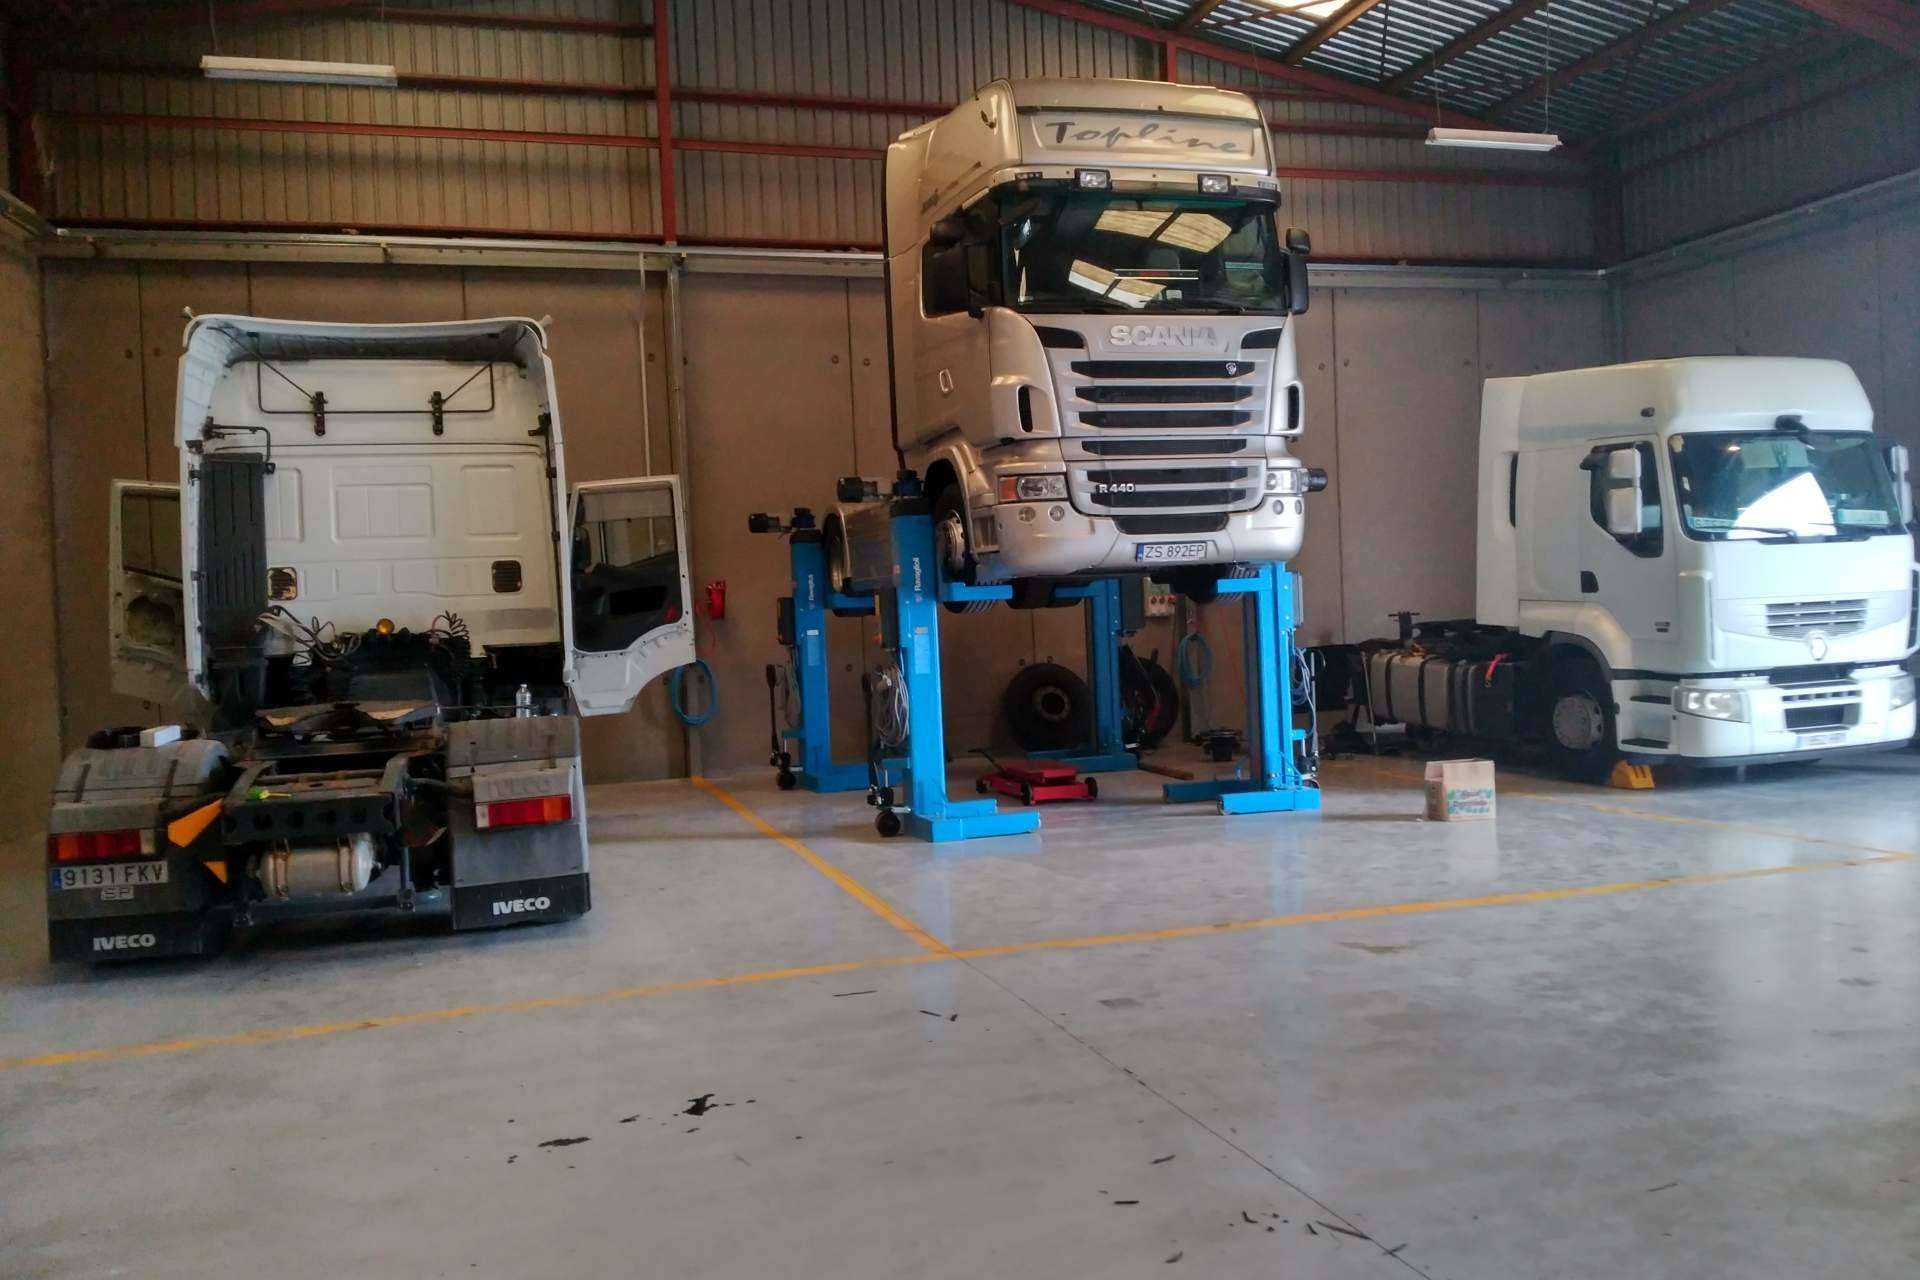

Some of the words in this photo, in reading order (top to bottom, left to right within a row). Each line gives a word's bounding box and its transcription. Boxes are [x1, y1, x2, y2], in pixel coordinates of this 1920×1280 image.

[1046, 121, 1240, 152] Topline
[1109, 325, 1217, 347] SCANIA
[1099, 484, 1108, 493] R
[1109, 483, 1135, 493] 440
[1145, 546, 1163, 559] ZS
[1166, 544, 1205, 558] 892EP
[64, 867, 116, 886] 9131
[124, 864, 162, 883] FKV
[492, 896, 551, 915] IVECO
[93, 933, 156, 951] IVECO
